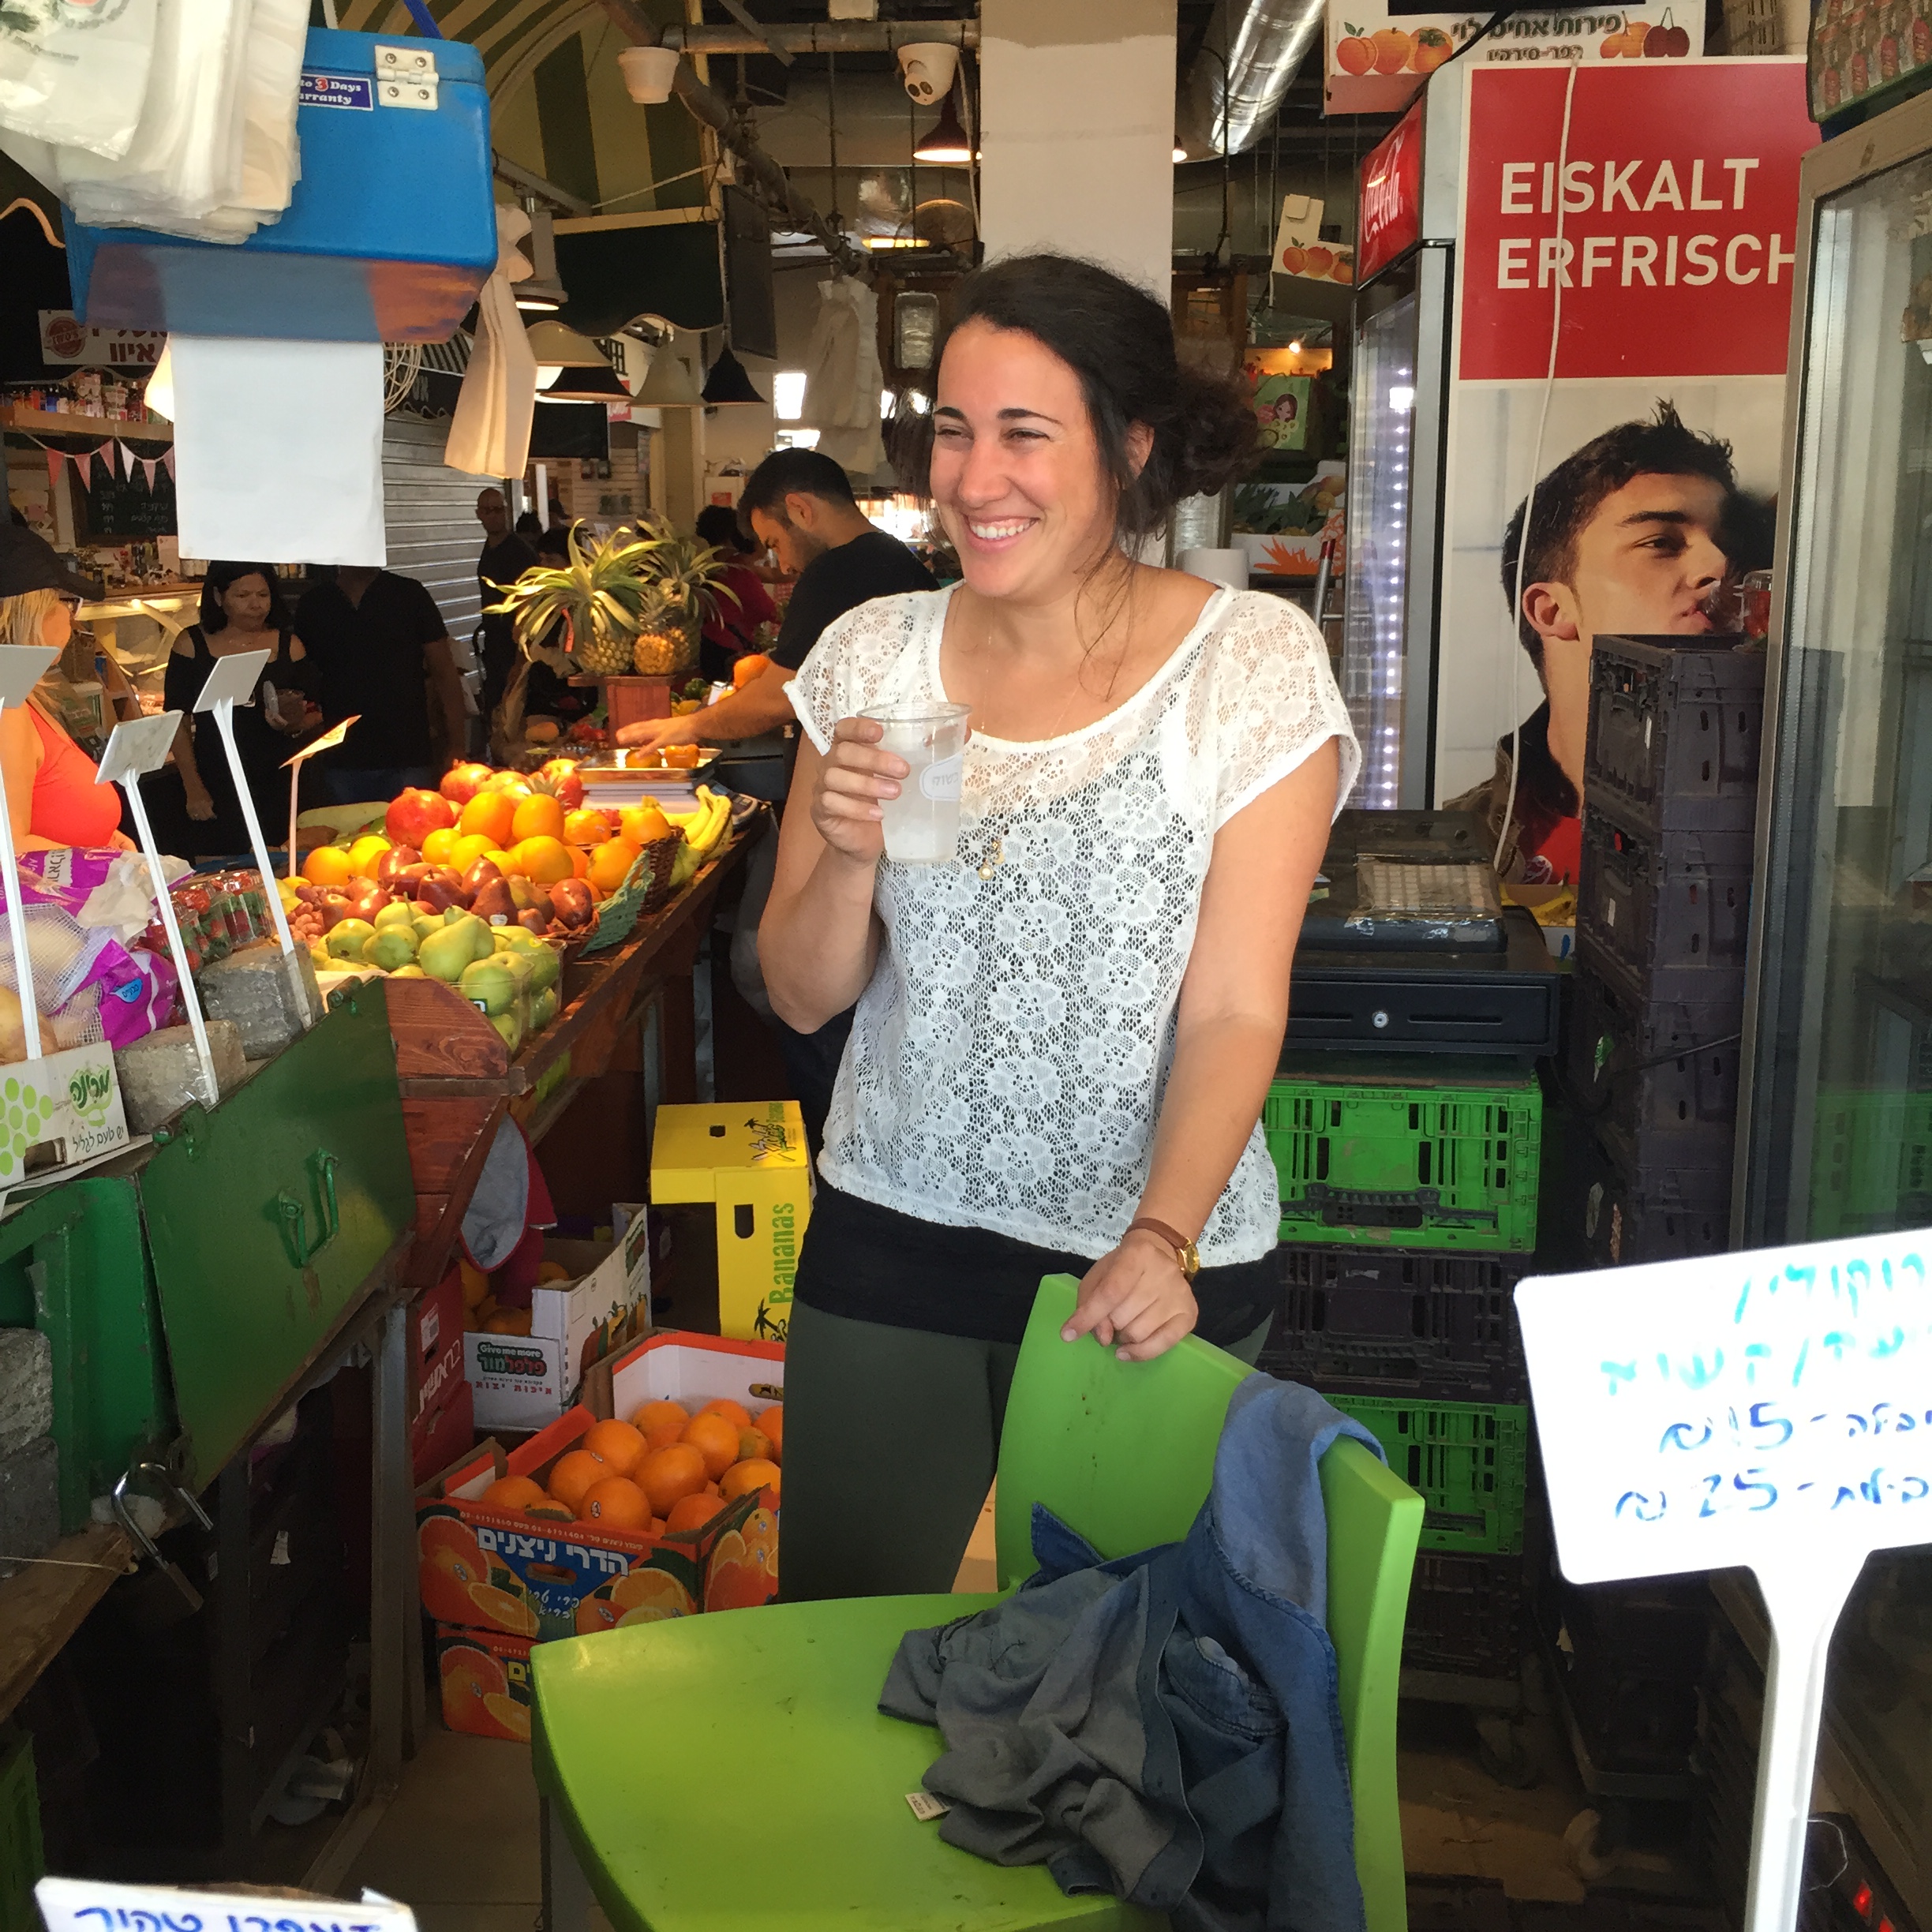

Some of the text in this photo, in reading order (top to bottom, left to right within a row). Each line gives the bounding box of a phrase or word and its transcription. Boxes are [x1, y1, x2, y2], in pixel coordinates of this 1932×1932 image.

[1451, 13, 1623, 42] פירות אחים לוי
[315, 77, 329, 92] 3
[330, 81, 361, 93] Days
[1500, 159, 1759, 215] EISKALT
[1497, 233, 1795, 290] ERFRISCH
[69, 1069, 110, 1110] מרינה
[769, 1202, 795, 1304] Bananas
[480, 1343, 501, 1354] Give
[517, 1349, 541, 1358] more
[1698, 1468, 1778, 1518] 25
[477, 1526, 629, 1577] הדרי ניצנים
